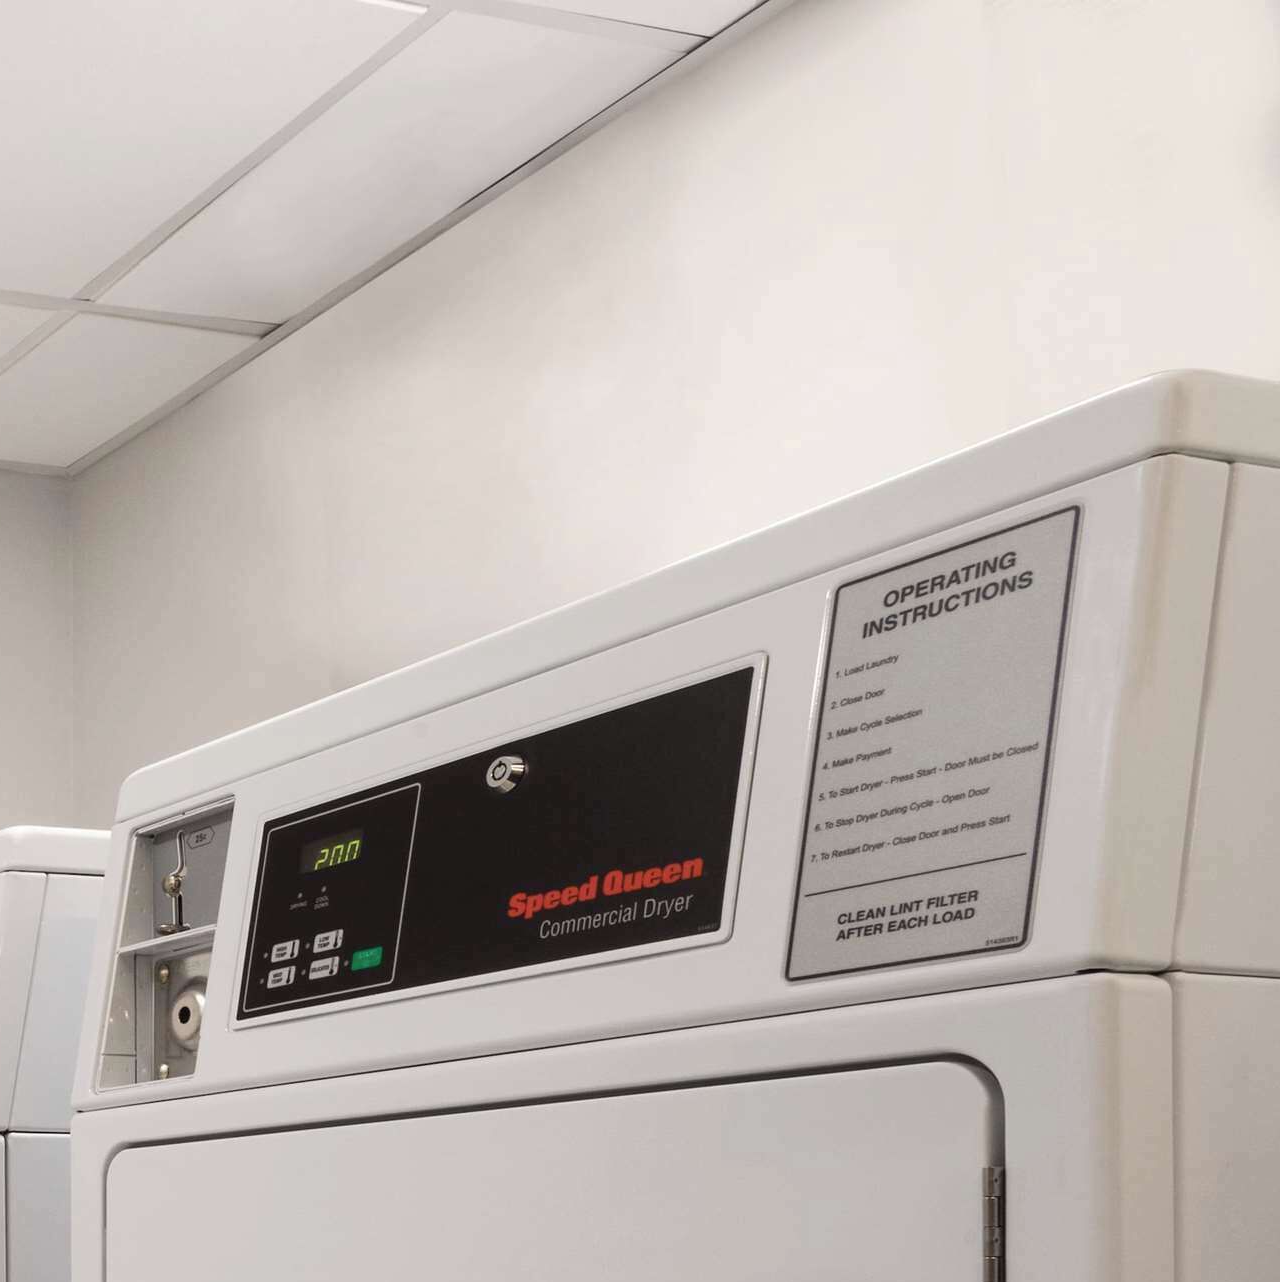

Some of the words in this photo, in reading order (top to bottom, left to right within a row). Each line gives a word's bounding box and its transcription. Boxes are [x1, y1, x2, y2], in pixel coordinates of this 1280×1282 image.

[883, 552, 1017, 607] OPERATING
[863, 571, 1033, 639] INSTRUCTIONS
[844, 664, 865, 676] Load
[866, 655, 899, 670] Laundry
[840, 696, 863, 707] Close
[865, 689, 885, 700] Door
[836, 727, 858, 737] Make
[860, 720, 883, 732] Cycle
[885, 709, 923, 724] Selection
[832, 758, 854, 768] Make
[855, 747, 892, 762] Payment
[840, 786, 859, 796] Start
[860, 780, 883, 792] Dryer
[890, 773, 914, 784] Press
[916, 767, 937, 778] Start
[945, 760, 967, 771] Door
[968, 754, 990, 766] Must
[1006, 742, 1039, 756] Closed
[835, 818, 854, 827] Stop
[856, 812, 879, 823] Dryer
[880, 806, 908, 818] During
[909, 800, 934, 812] Cycle
[941, 792, 966, 804] Open
[968, 787, 990, 798] Door
[831, 846, 861, 858] Restart
[862, 842, 885, 852] Dryer
[892, 836, 917, 846] Close
[919, 830, 940, 840] Door
[941, 825, 959, 836] and
[961, 820, 986, 832] Press
[988, 814, 1011, 826] Start
[507, 875, 597, 919] Speed
[602, 857, 703, 897] Queen
[837, 906, 886, 925] CLEAN
[890, 900, 923, 916] LINT
[927, 890, 979, 909] FILTER
[539, 902, 637, 939] Commercial
[642, 894, 693, 921] Dryer
[836, 923, 883, 941] AFTER
[887, 915, 929, 932] EACH
[932, 908, 975, 924] LOAD
